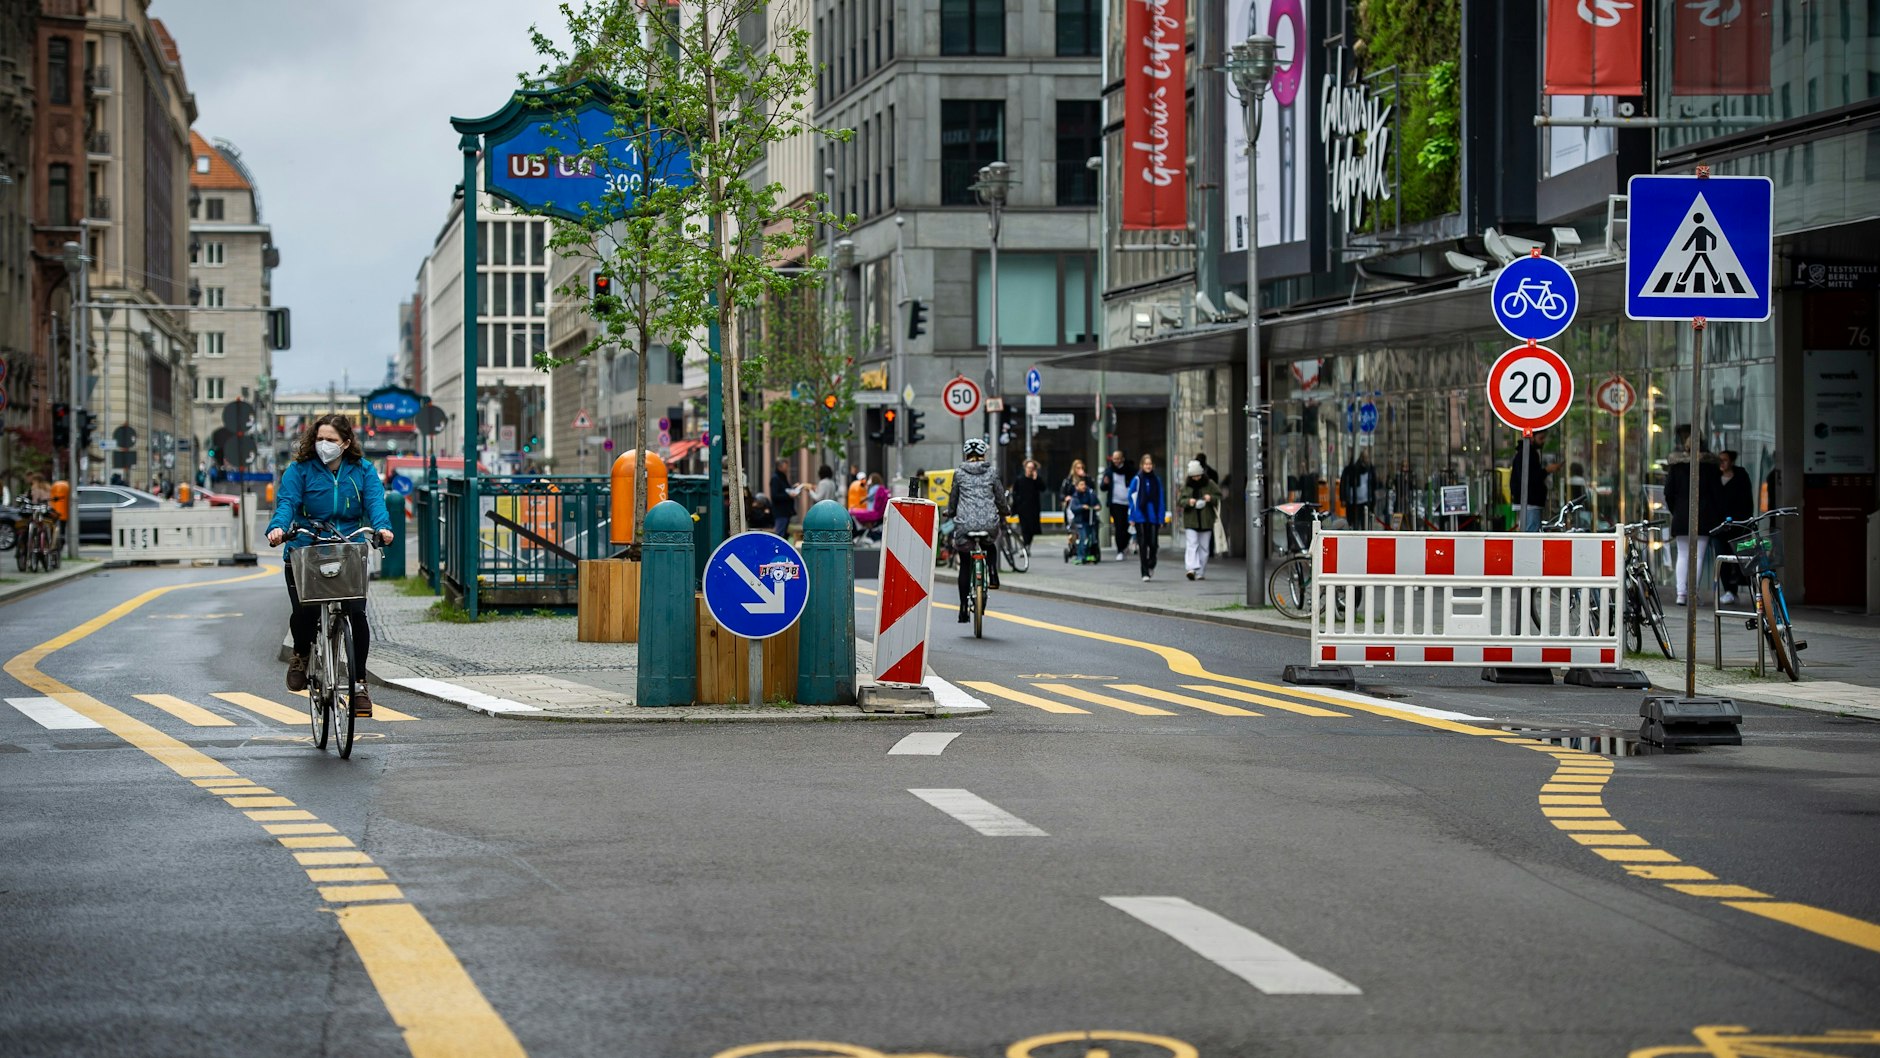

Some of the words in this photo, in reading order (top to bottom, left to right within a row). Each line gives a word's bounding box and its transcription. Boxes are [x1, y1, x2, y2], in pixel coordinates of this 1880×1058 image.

[512, 155, 546, 177] U5
[559, 155, 593, 177] U6
[604, 174, 642, 193] 300
[1828, 265, 1879, 273] TESTSTELLE
[1847, 326, 1871, 346] 76
[952, 389, 973, 405] 50
[1509, 371, 1551, 404] 20
